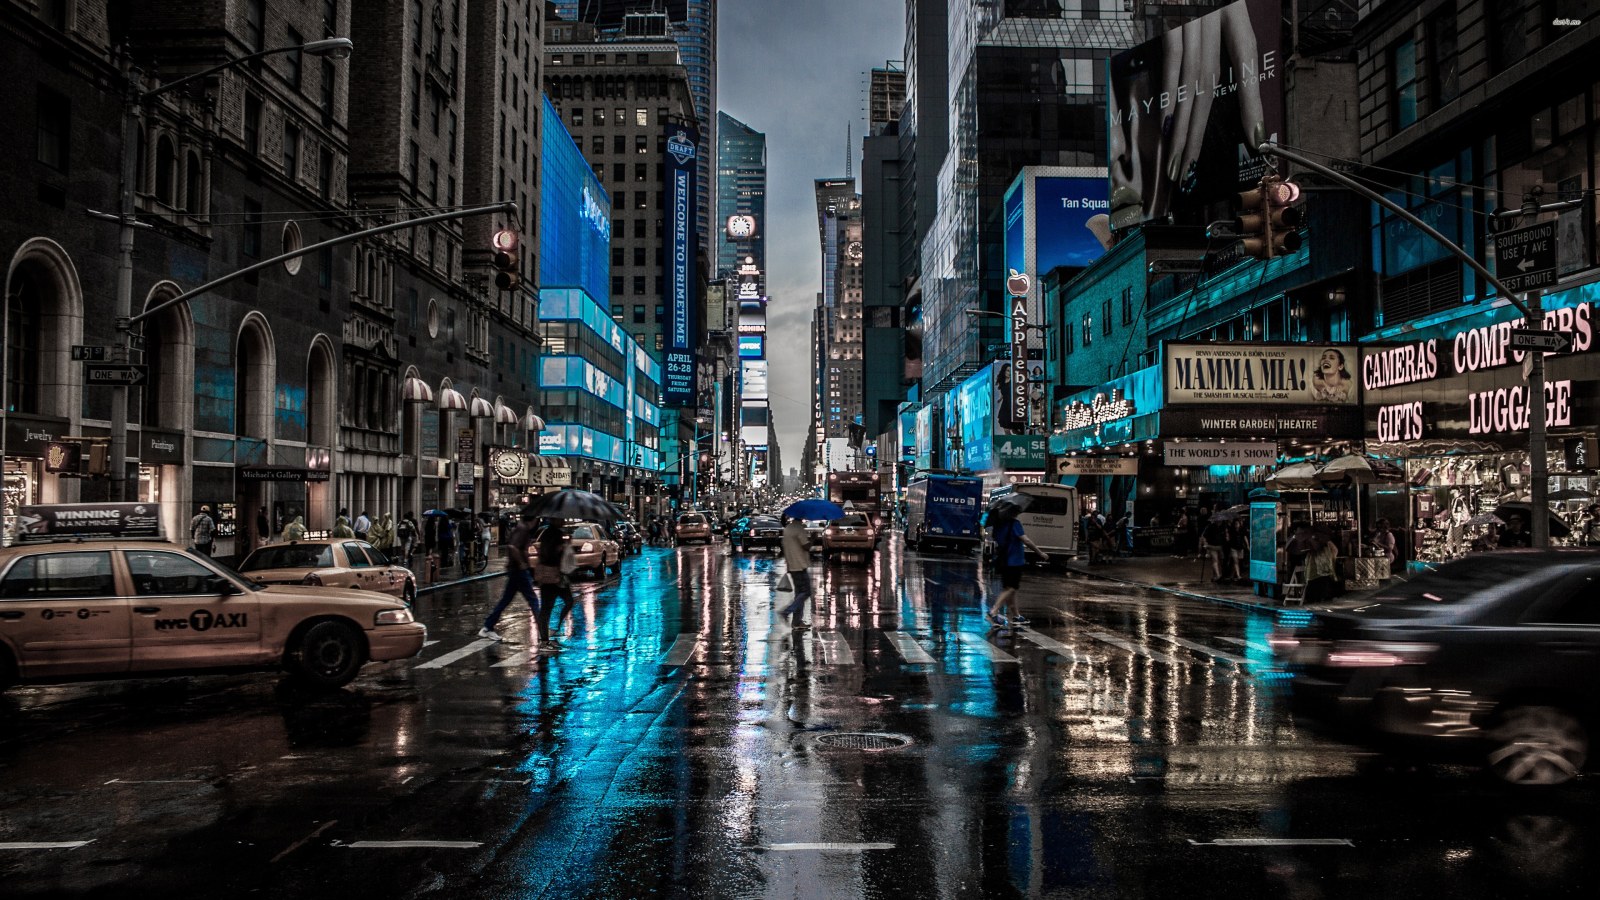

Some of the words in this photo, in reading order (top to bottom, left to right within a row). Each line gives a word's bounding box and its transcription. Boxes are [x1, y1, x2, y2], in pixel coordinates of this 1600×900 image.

[1110, 50, 1277, 128] MAYBELLINE
[1213, 83, 1238, 98] NEW
[1242, 69, 1276, 88] YORK
[670, 143, 693, 155] DRAFT
[677, 175, 686, 240] WELCOME
[1061, 197, 1080, 208] Tan
[1497, 226, 1553, 249] SOUTHBOUND
[676, 243, 685, 261] TO
[1502, 247, 1519, 260] USE
[1522, 245, 1528, 255] 7
[1532, 240, 1549, 254] AVE
[1524, 270, 1553, 286] ROUTE
[676, 266, 685, 343] PRIMETIME
[1454, 302, 1592, 374] COMPUERS
[1518, 335, 1536, 345] ONE
[1544, 336, 1562, 347] WAY
[73, 347, 81, 360] W
[83, 347, 92, 360] 51
[667, 353, 692, 363] APRIL
[1012, 300, 1027, 418] Applebee's
[667, 363, 691, 373] 26-28
[1363, 339, 1437, 390] CAMERAS
[94, 370, 113, 379] ONE
[120, 371, 139, 380] WAY
[1174, 357, 1255, 390] MAMMA
[1260, 357, 1306, 391] MIA!
[1201, 418, 1237, 429] WINTER
[1239, 418, 1275, 429] GARDEN
[1278, 418, 1318, 430] THEATRE
[1377, 401, 1423, 443] GIFTS
[24, 428, 53, 442] Jewelry
[151, 439, 175, 453] Paintings
[1000, 441, 1013, 456] 4
[1169, 449, 1186, 458] THE
[1187, 449, 1228, 458] WORLD'S
[1230, 449, 1241, 458] #1
[1242, 449, 1274, 458] SHOW!
[242, 470, 275, 479] Michael's
[275, 471, 302, 481] Gallery
[933, 496, 966, 504] UNITED
[54, 510, 121, 520] WINNING
[55, 520, 66, 528] IN
[66, 520, 86, 528] ANY
[86, 519, 119, 527] MINUTE
[154, 618, 188, 630] NYC
[190, 609, 248, 632] TAXI
